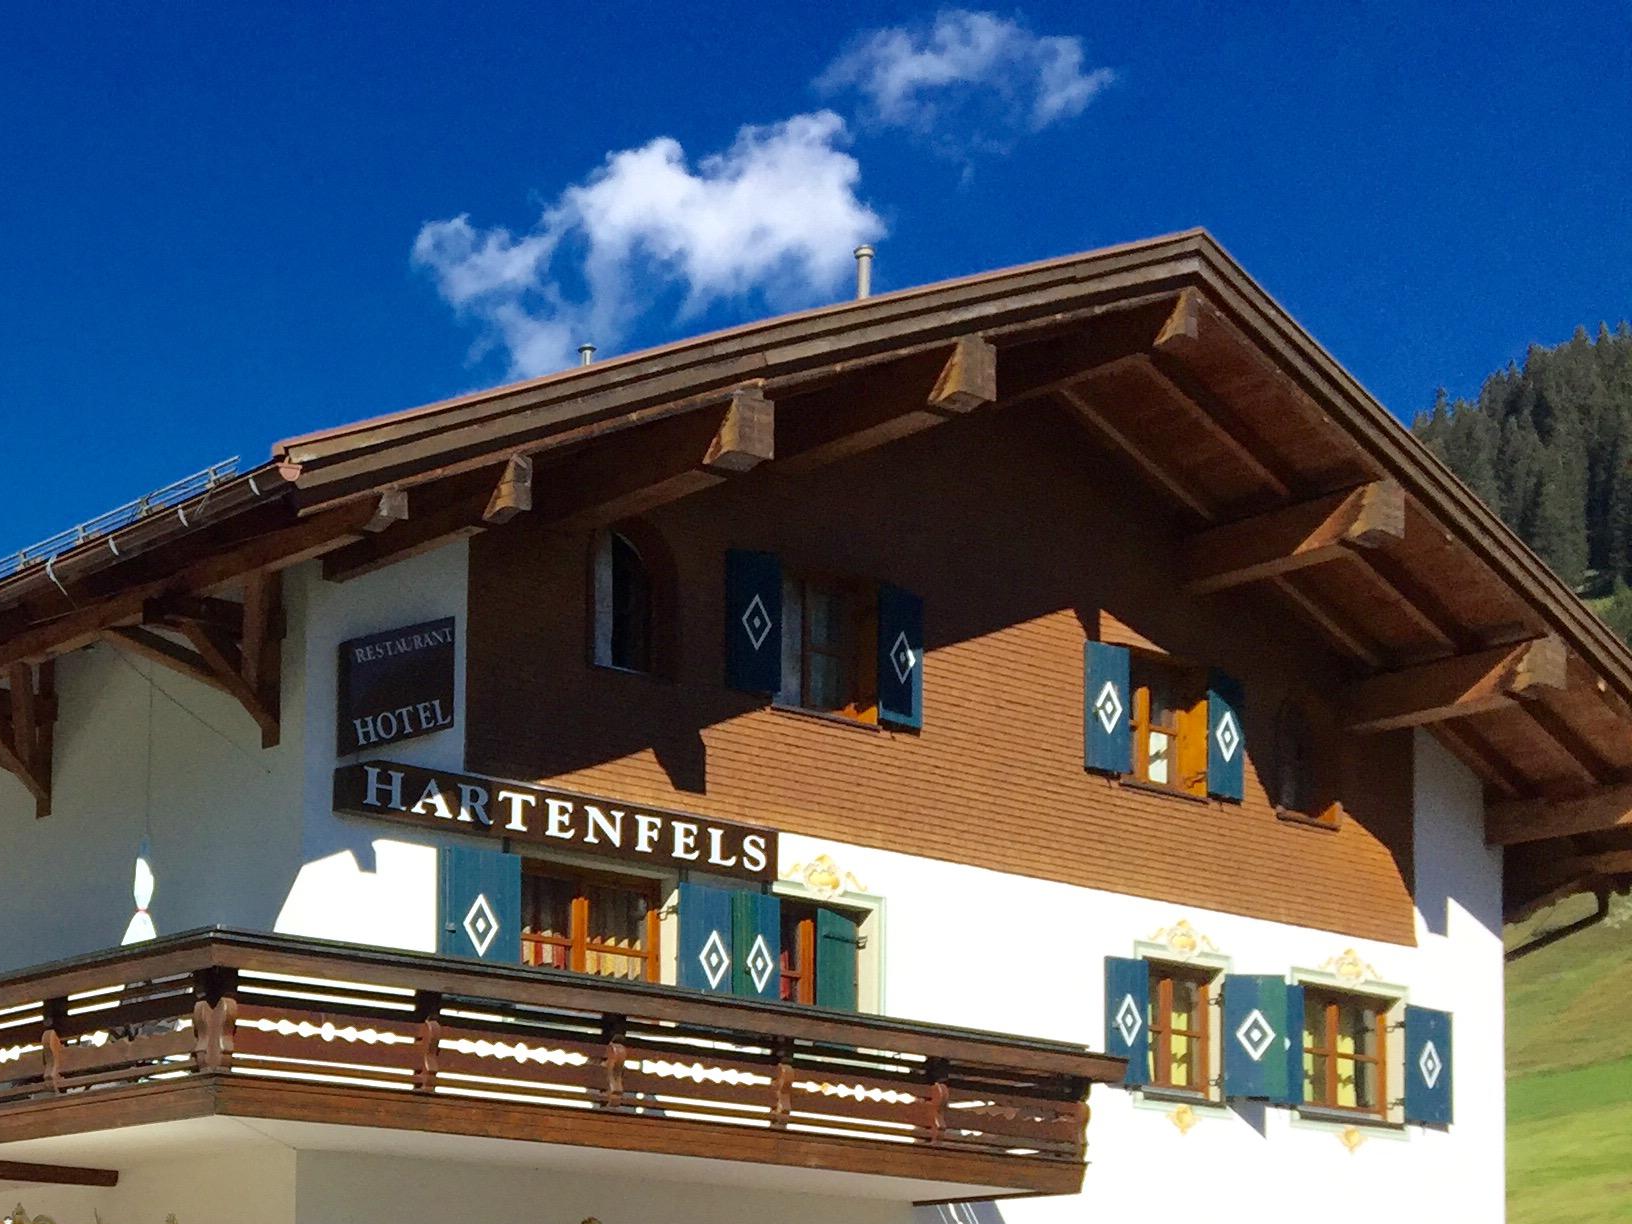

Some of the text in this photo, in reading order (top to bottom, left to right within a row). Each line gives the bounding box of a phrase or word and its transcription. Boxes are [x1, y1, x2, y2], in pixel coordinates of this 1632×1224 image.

[355, 625, 455, 665] RESTAURANT
[353, 698, 452, 748] HOTEL
[362, 764, 768, 872] HARTENFELS
